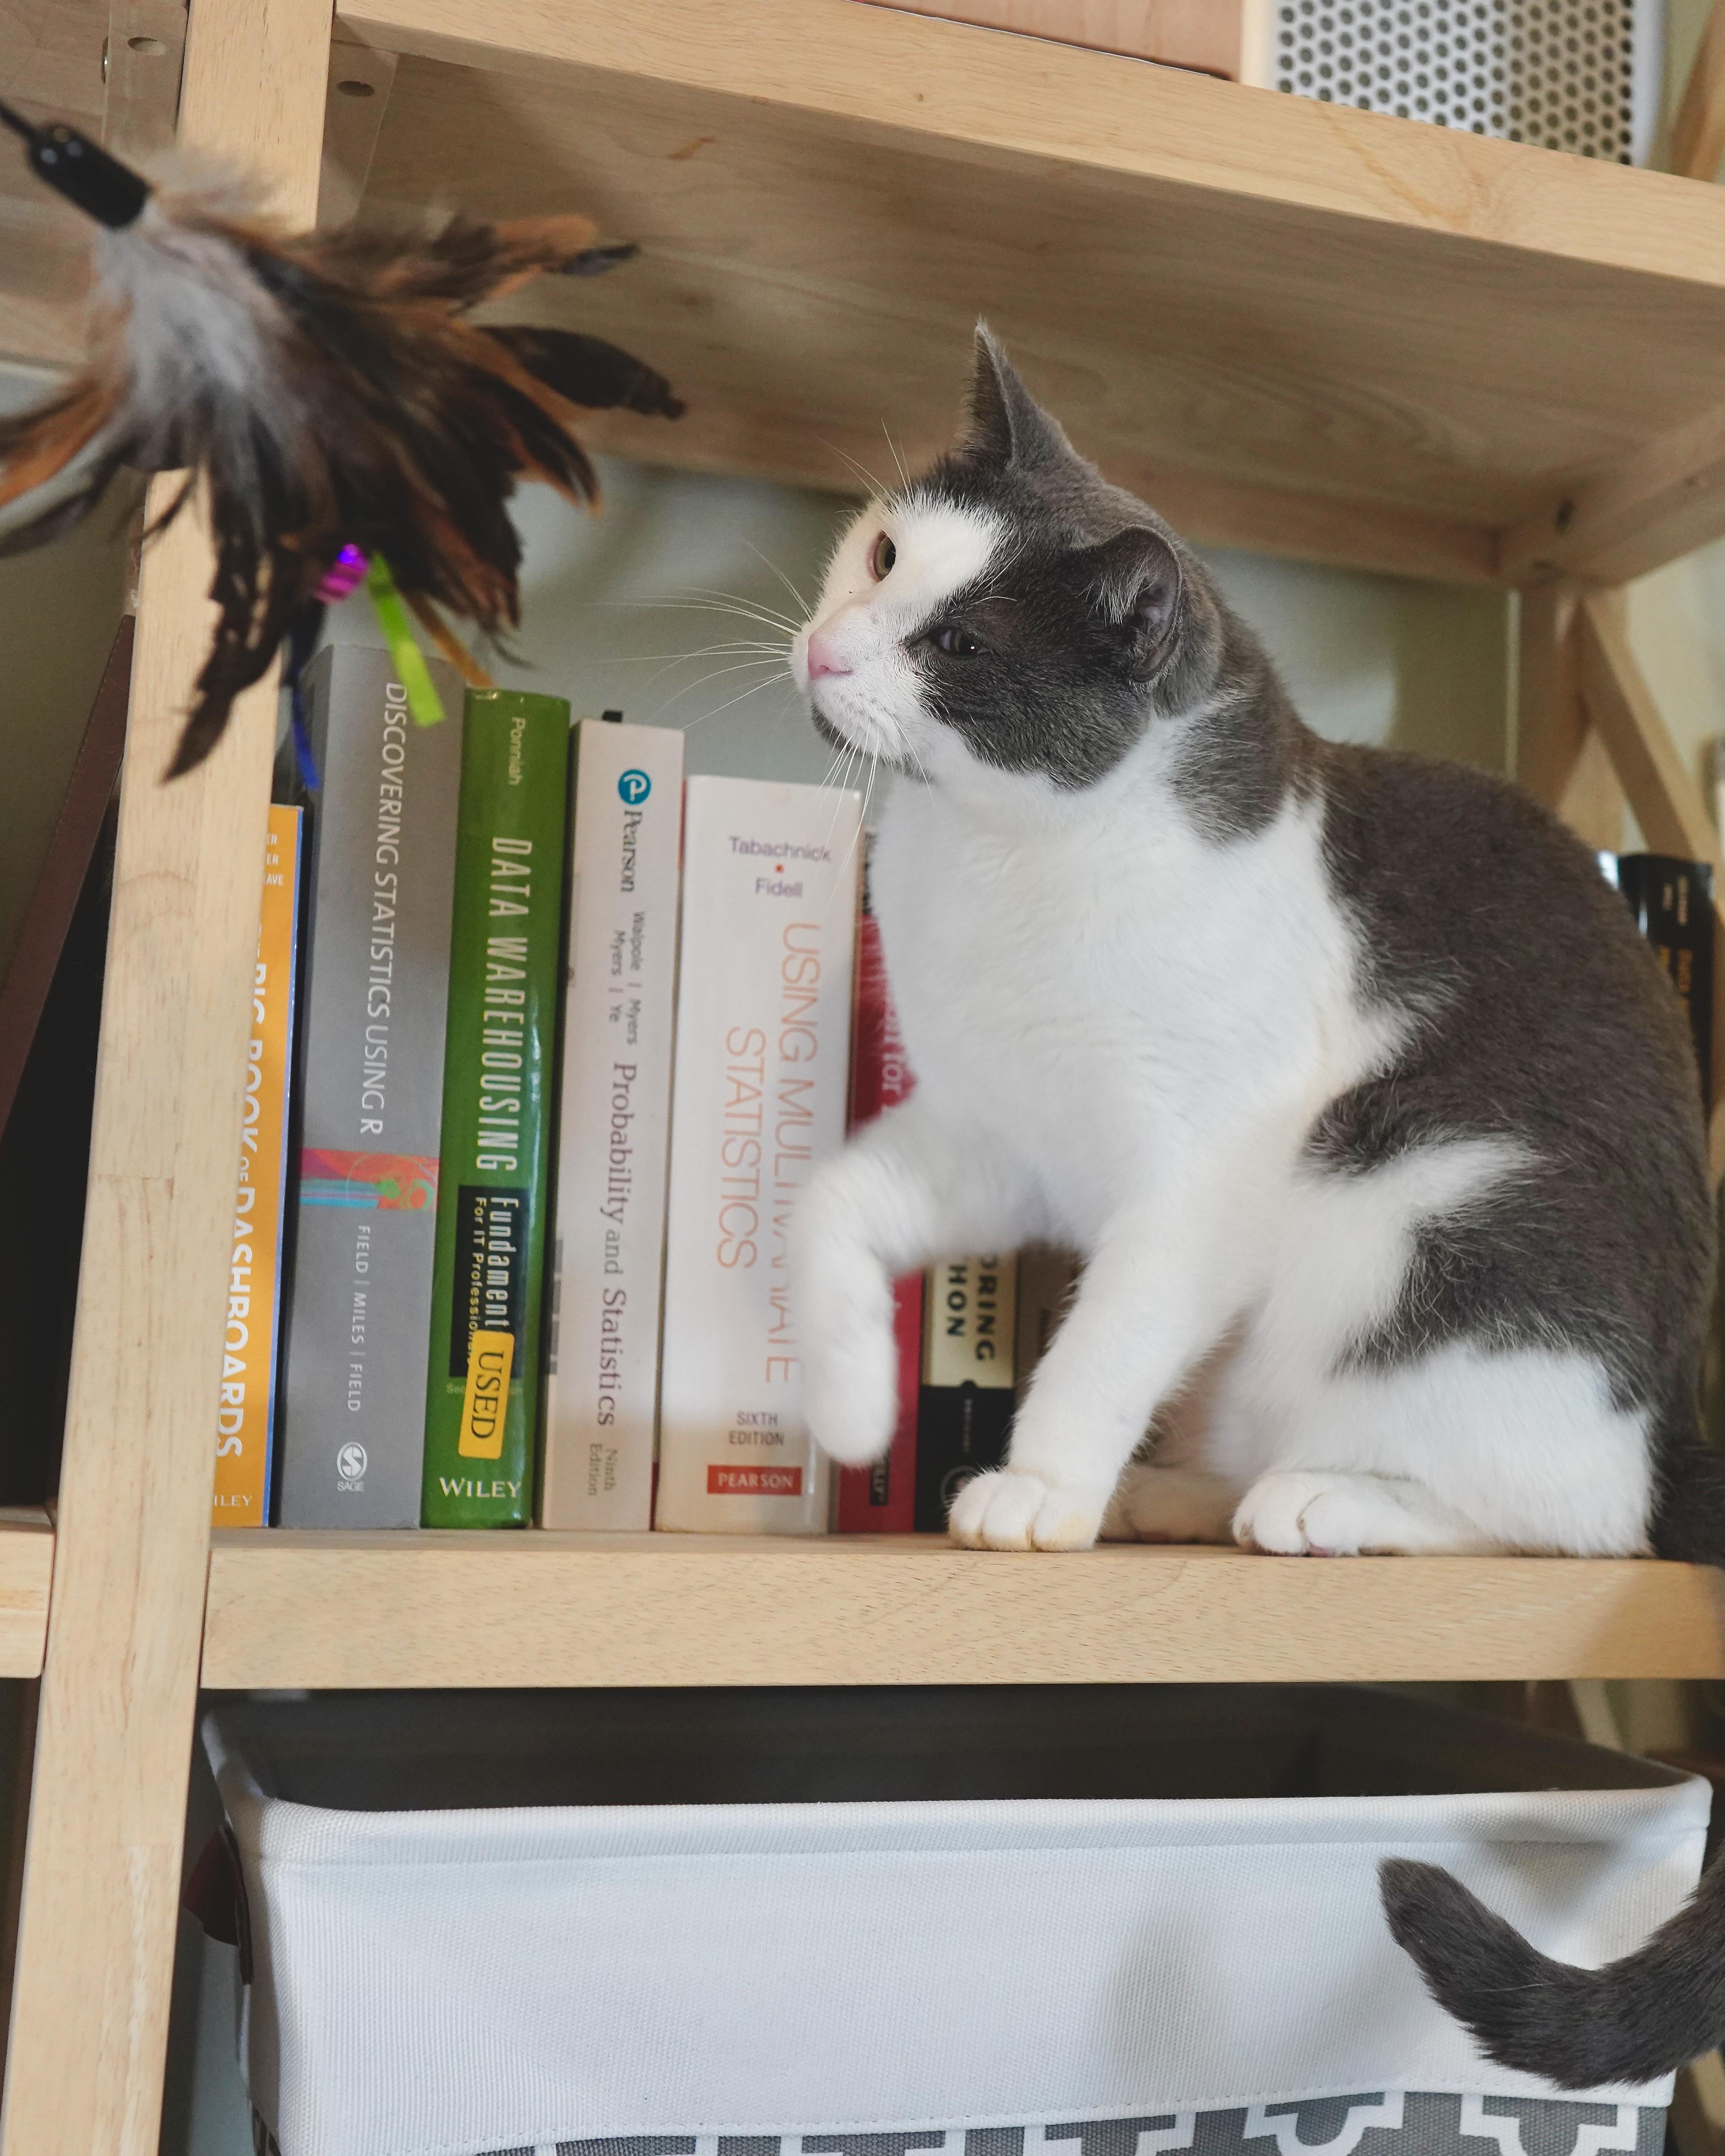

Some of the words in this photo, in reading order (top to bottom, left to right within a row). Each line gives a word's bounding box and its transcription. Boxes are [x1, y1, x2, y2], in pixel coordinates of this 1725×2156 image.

[376, 682, 407, 864] DISCOVERING
[620, 809, 643, 893] Pearson
[729, 836, 832, 862] Tabachnick
[488, 837, 532, 917] DATA
[755, 878, 803, 898] Fidell
[368, 871, 397, 1018] STATISTICS
[609, 929, 626, 977] Myers
[630, 911, 646, 971] Walpole
[609, 1004, 624, 1024] Ye
[778, 922, 821, 1063] USING
[626, 998, 642, 1046] Myers
[361, 1025, 389, 1110] USING
[476, 937, 528, 1172] WAREHOUSING
[360, 1118, 382, 1135] R
[600, 1062, 638, 1226] Probability
[717, 1026, 767, 1271] STATISTICS
[473, 1197, 487, 1224] For
[355, 1226, 370, 1273] FIELD
[473, 1230, 485, 1246] IT
[604, 1229, 623, 1275] and
[351, 1291, 366, 1345] MILES
[946, 1264, 968, 1337] HON
[596, 1287, 627, 1427] Statistics
[347, 1363, 362, 1413] FIELD
[470, 1349, 505, 1440] USED
[728, 1430, 785, 1447] EDITION
[736, 1410, 780, 1427] SIXTH
[336, 1480, 364, 1492] SAGE
[439, 1476, 522, 1499] WILEY
[588, 1443, 603, 1496] Edition
[605, 1449, 618, 1492] Ninth
[717, 1473, 794, 1489] PEARSON
[214, 1494, 252, 1507] ILEY
